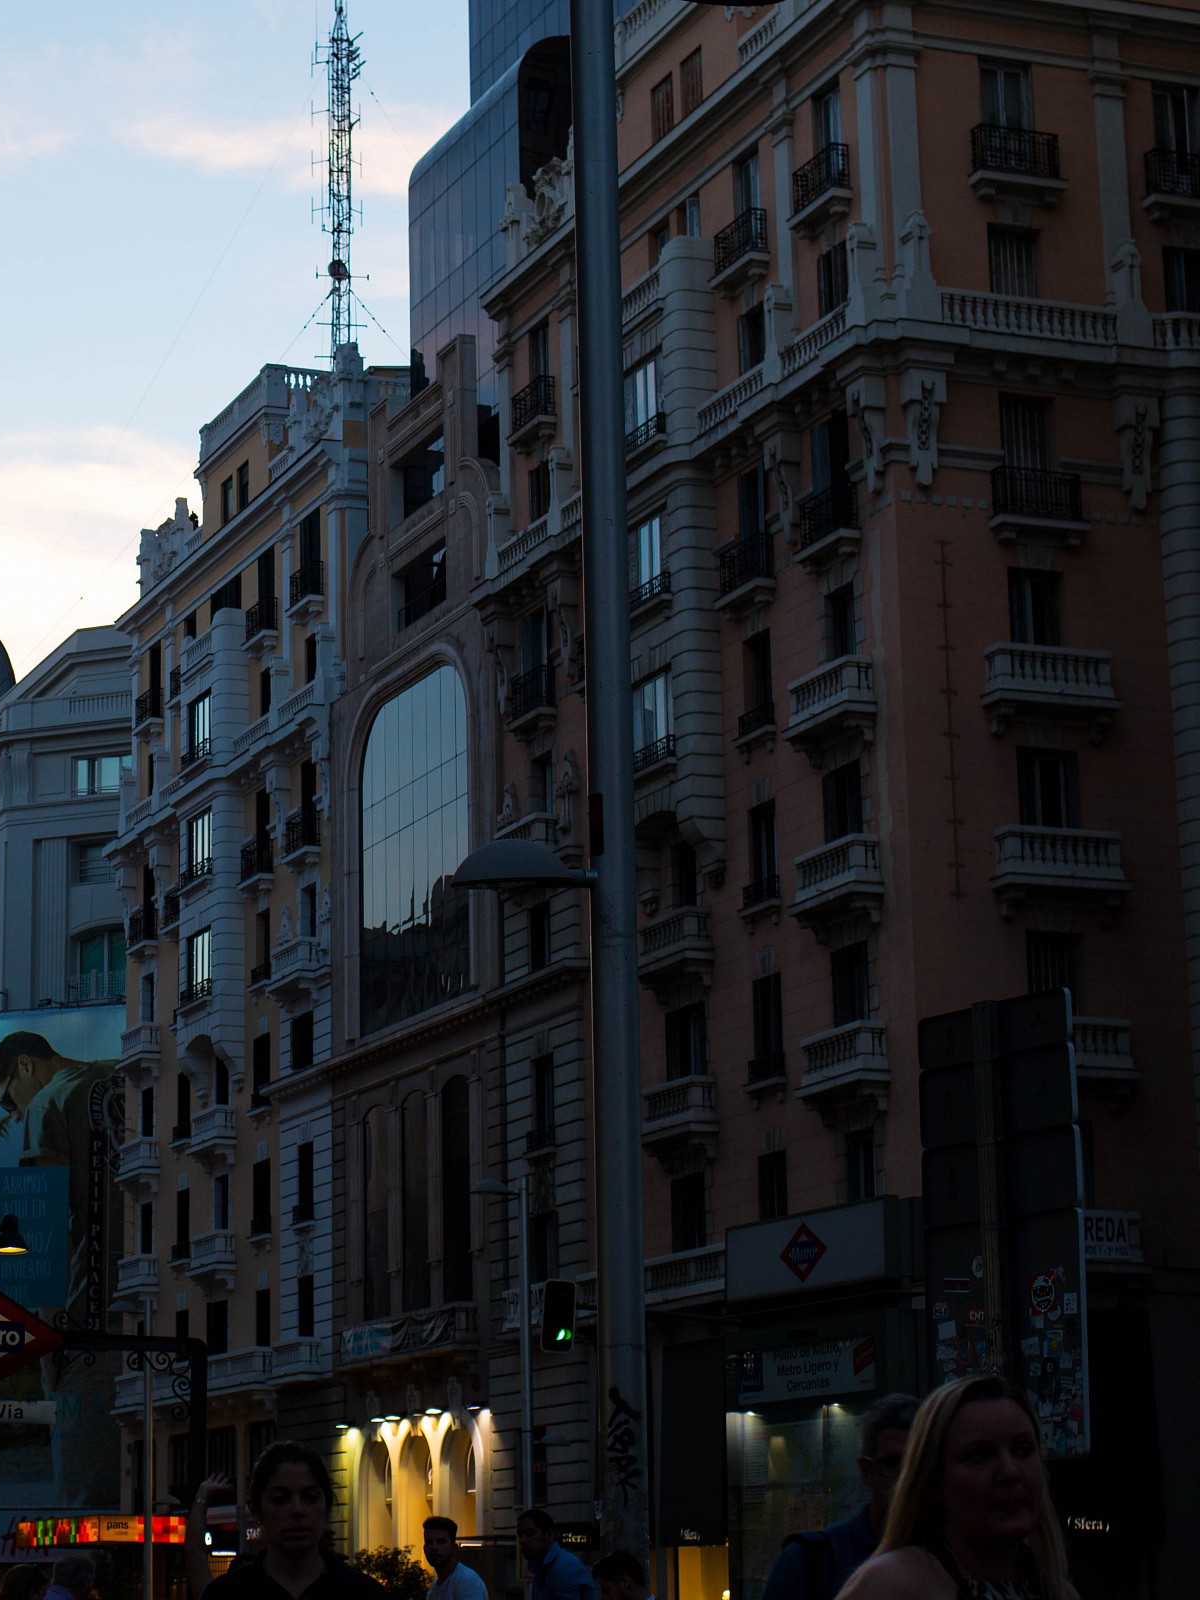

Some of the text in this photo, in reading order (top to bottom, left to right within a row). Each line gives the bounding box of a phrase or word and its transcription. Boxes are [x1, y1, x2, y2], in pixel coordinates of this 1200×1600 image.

[2, 1173, 48, 1195] ABRIMOS
[91, 1140, 103, 1214] PETIT
[32, 1199, 46, 1219] EN
[791, 1245, 816, 1263] Metro
[1, 1258, 52, 1280] INVIERNO
[89, 1223, 102, 1314] PALACE
[969, 1311, 986, 1321] CNT
[800, 1345, 810, 1358] de
[777, 1360, 840, 1377] Metro Ligero y
[106, 1520, 129, 1532] pans
